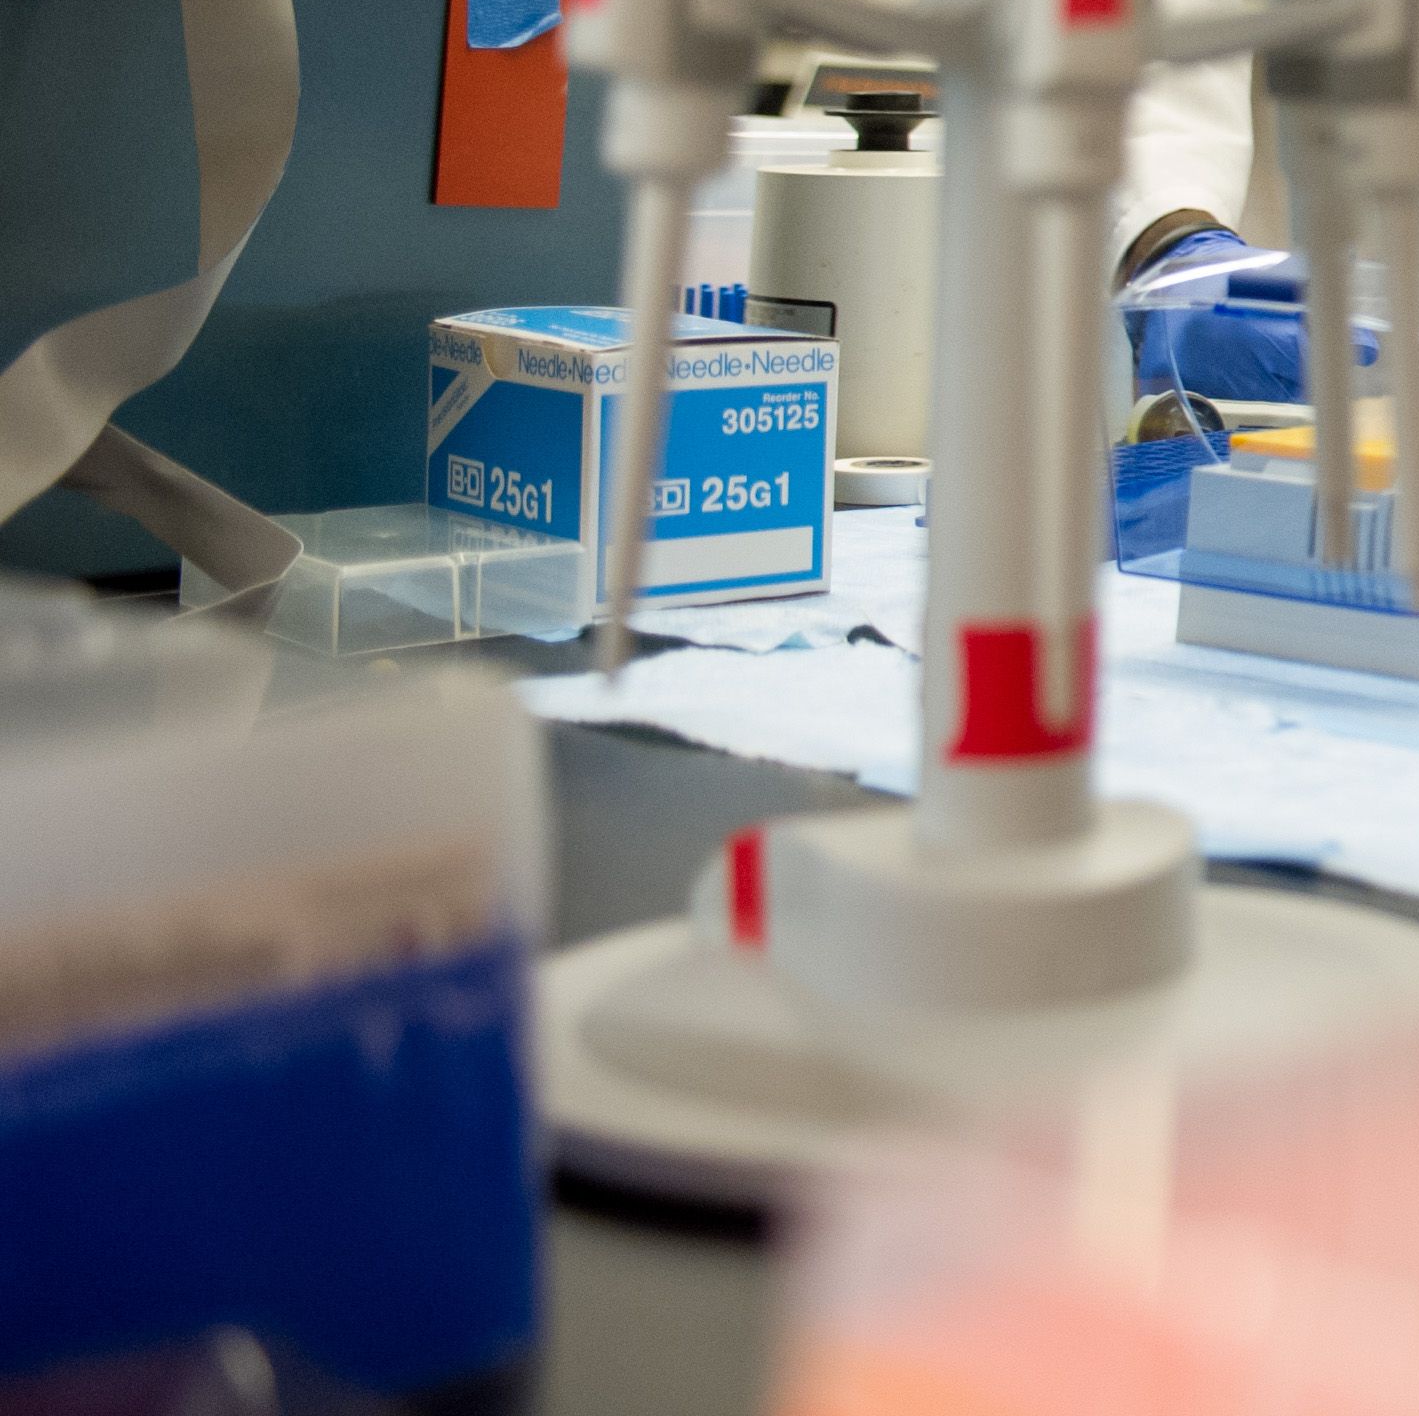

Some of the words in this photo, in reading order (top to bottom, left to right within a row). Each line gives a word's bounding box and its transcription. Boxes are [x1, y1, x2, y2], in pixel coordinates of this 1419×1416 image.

[722, 403, 820, 436] 305125
[490, 465, 553, 524] 25G1
[701, 471, 791, 514] 25G1
